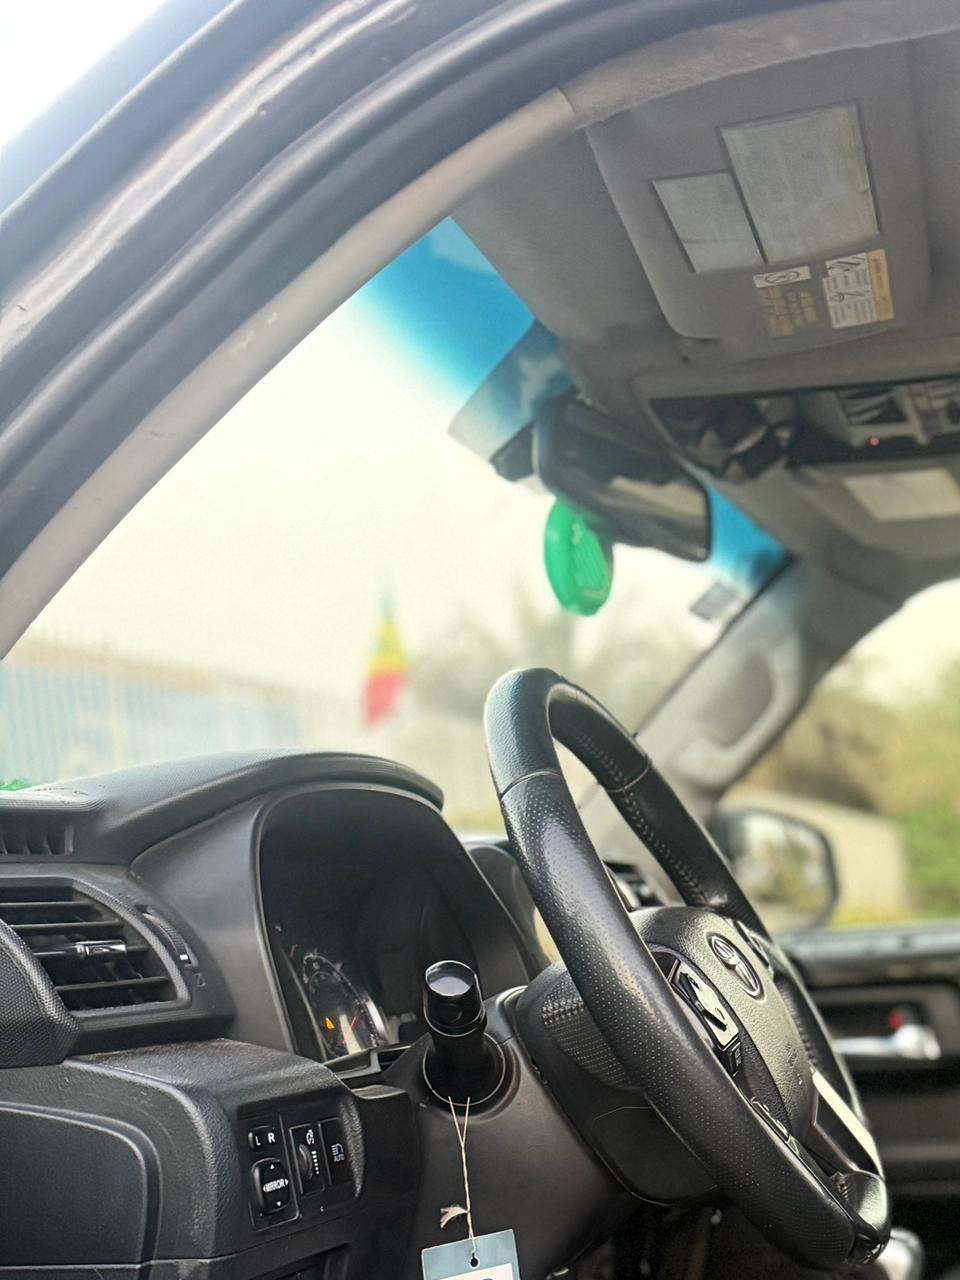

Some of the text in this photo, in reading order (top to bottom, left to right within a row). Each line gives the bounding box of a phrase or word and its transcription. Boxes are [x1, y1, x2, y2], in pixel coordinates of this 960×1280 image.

[255, 1132, 276, 1146] L R
[265, 1179, 286, 1192] MIRROR
